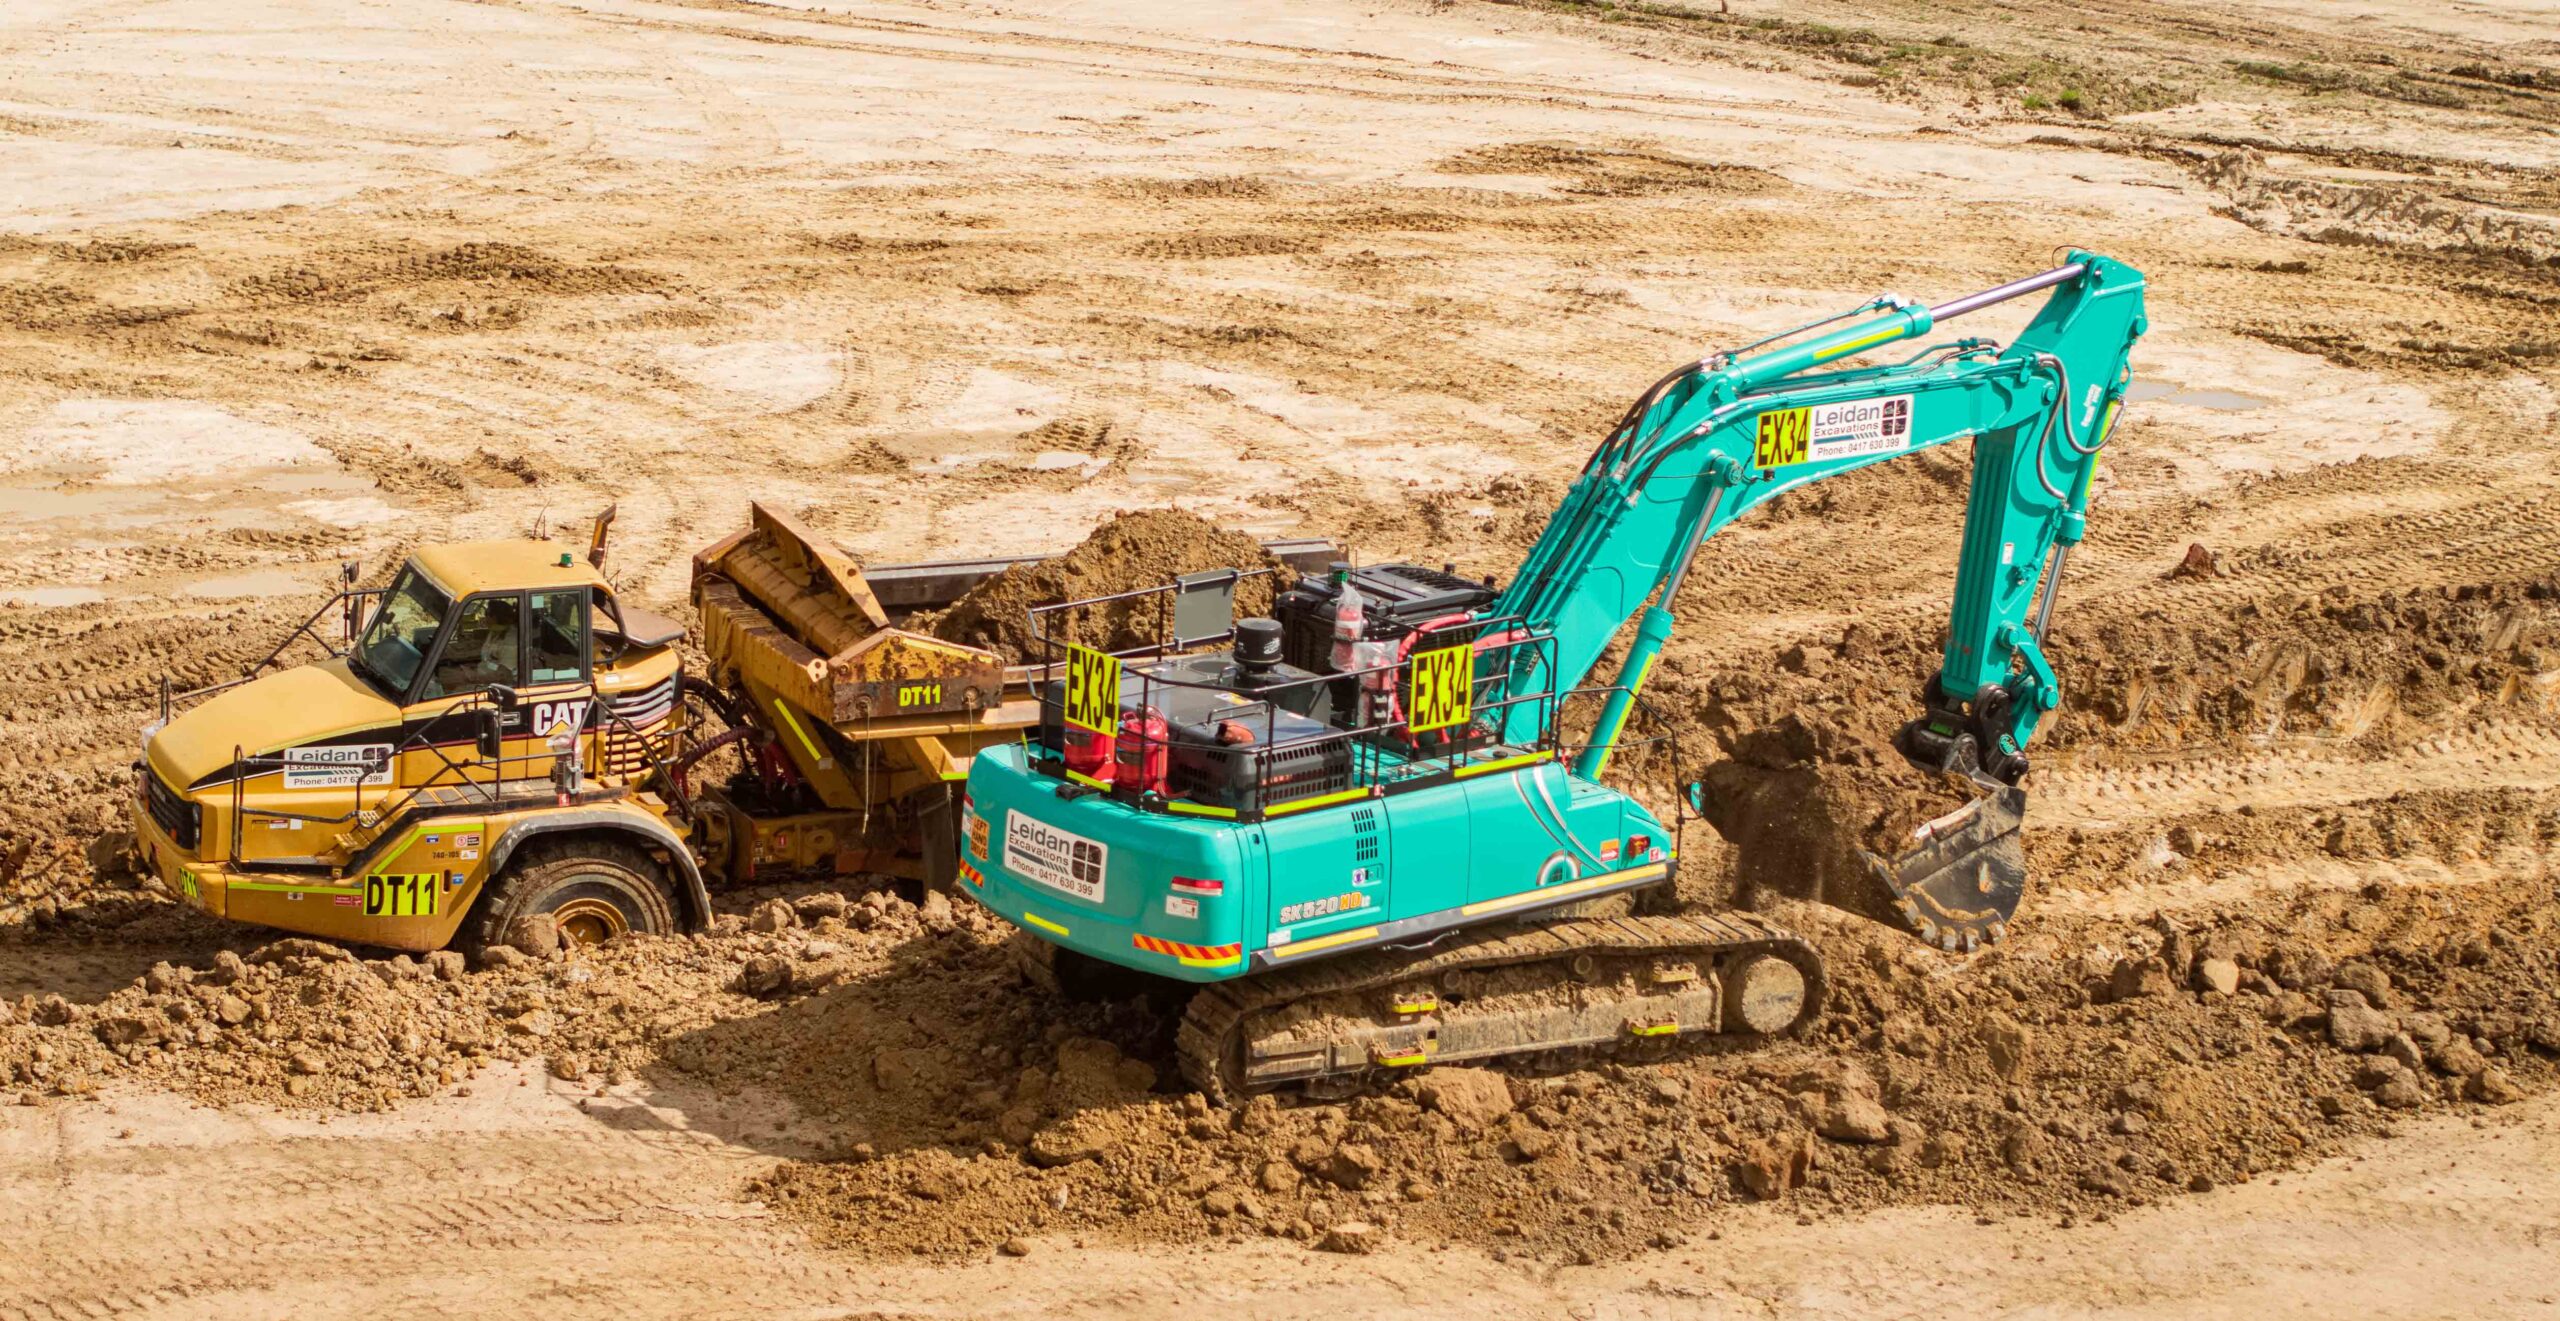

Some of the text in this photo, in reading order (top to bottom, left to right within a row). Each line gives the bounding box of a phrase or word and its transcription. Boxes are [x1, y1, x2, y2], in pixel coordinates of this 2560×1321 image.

[1814, 422, 1879, 437] Excavations
[1815, 405, 1880, 427] Leidan
[1758, 409, 1808, 466] EX34
[1817, 437, 1900, 456] Phone: 0417 630 399
[900, 684, 941, 706] DT11
[1068, 647, 1116, 732] EX34
[1414, 648, 1468, 727] EX34
[534, 701, 587, 736] CAT
[288, 749, 359, 763] Leidan
[294, 777, 325, 786] Phone:
[327, 776, 348, 784] 0417
[368, 775, 383, 783] 399
[1009, 834, 1069, 866] Excavations
[1010, 814, 1070, 855] Leidan
[1012, 856, 1093, 896] Phone: 0417 630 399
[366, 874, 436, 915] DT11
